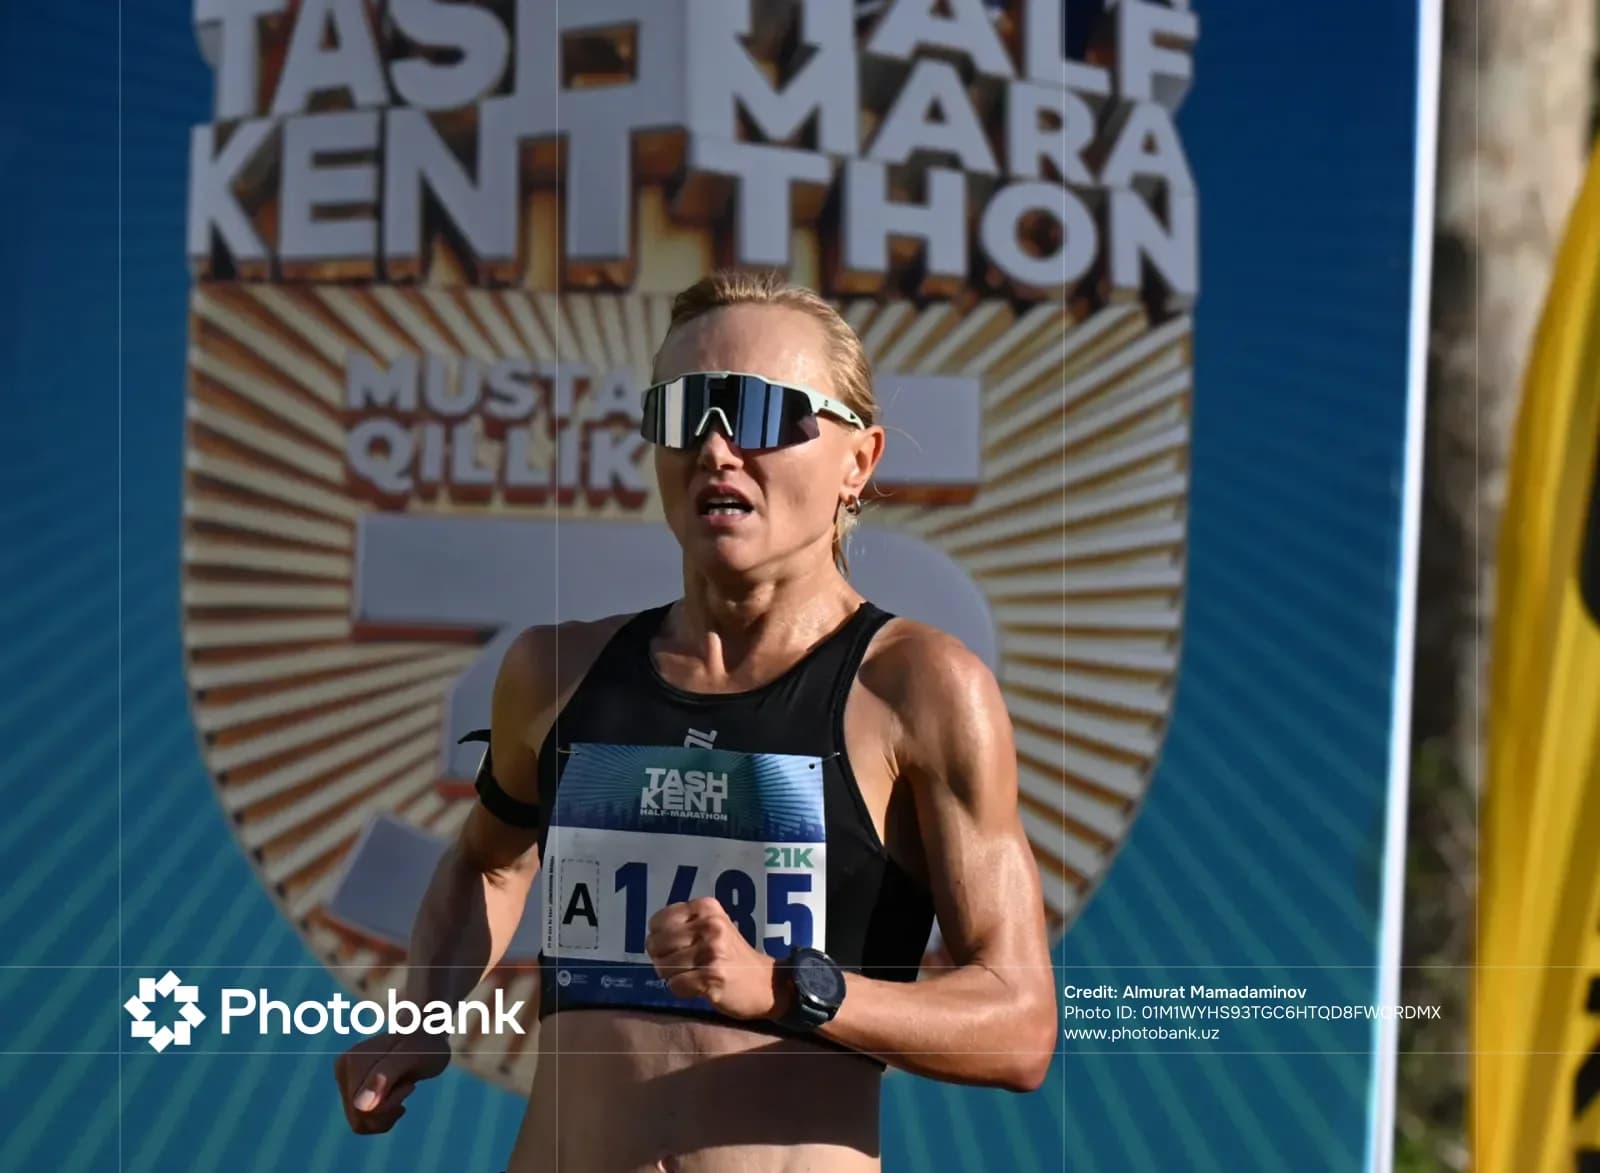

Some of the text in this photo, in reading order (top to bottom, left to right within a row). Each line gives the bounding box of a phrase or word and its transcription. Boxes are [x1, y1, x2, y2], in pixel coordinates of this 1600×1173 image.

[688, 34, 1195, 192] MARA
[187, 100, 688, 262] KENT
[688, 137, 1198, 297] THON
[345, 354, 646, 422] MUSTA
[345, 417, 650, 494] QILLIK
[641, 787, 727, 813] KENT
[645, 767, 728, 800] TASH
[640, 808, 728, 821] HALF-MARATHON
[764, 847, 814, 868] 21K
[562, 883, 598, 927] A
